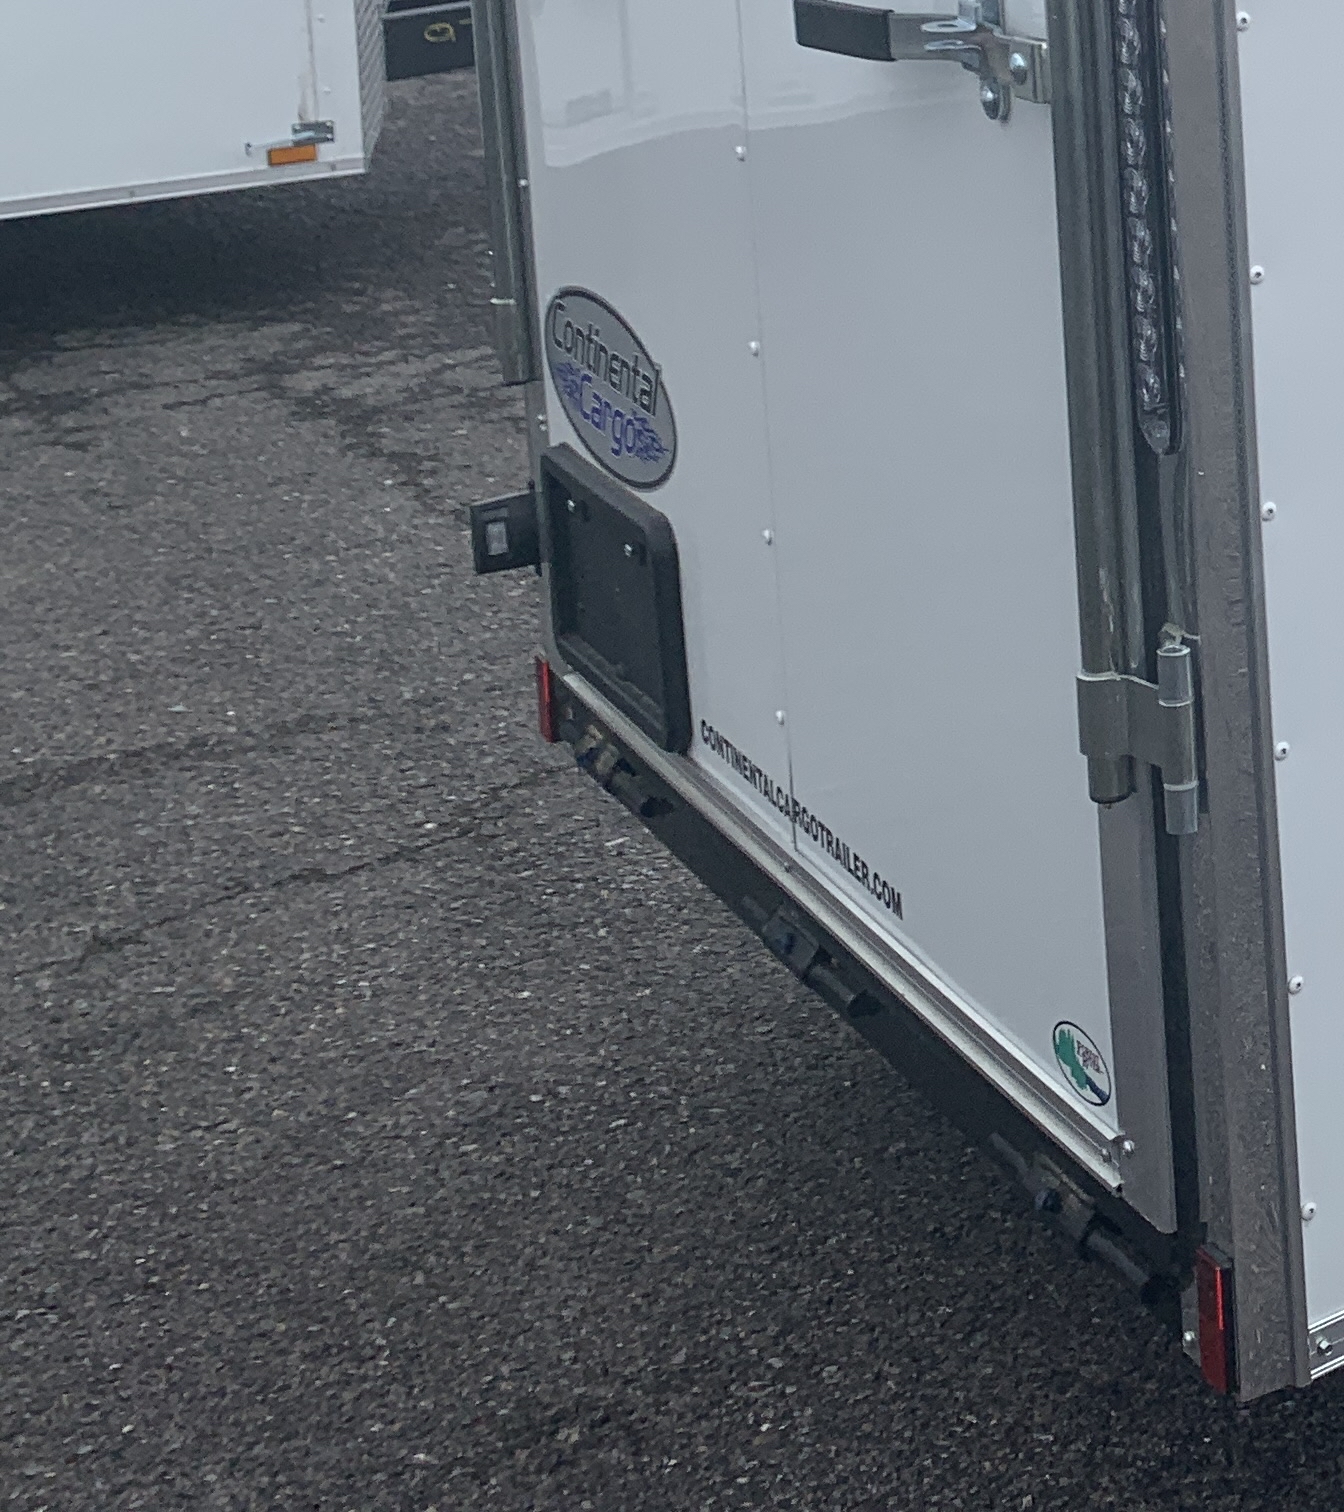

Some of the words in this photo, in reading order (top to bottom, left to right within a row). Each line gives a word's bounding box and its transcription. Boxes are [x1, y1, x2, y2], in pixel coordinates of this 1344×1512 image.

[552, 300, 660, 417] Continental
[580, 373, 638, 457] Cargo
[701, 719, 903, 921] CONTINENTALCARGOTRAILER.COM
